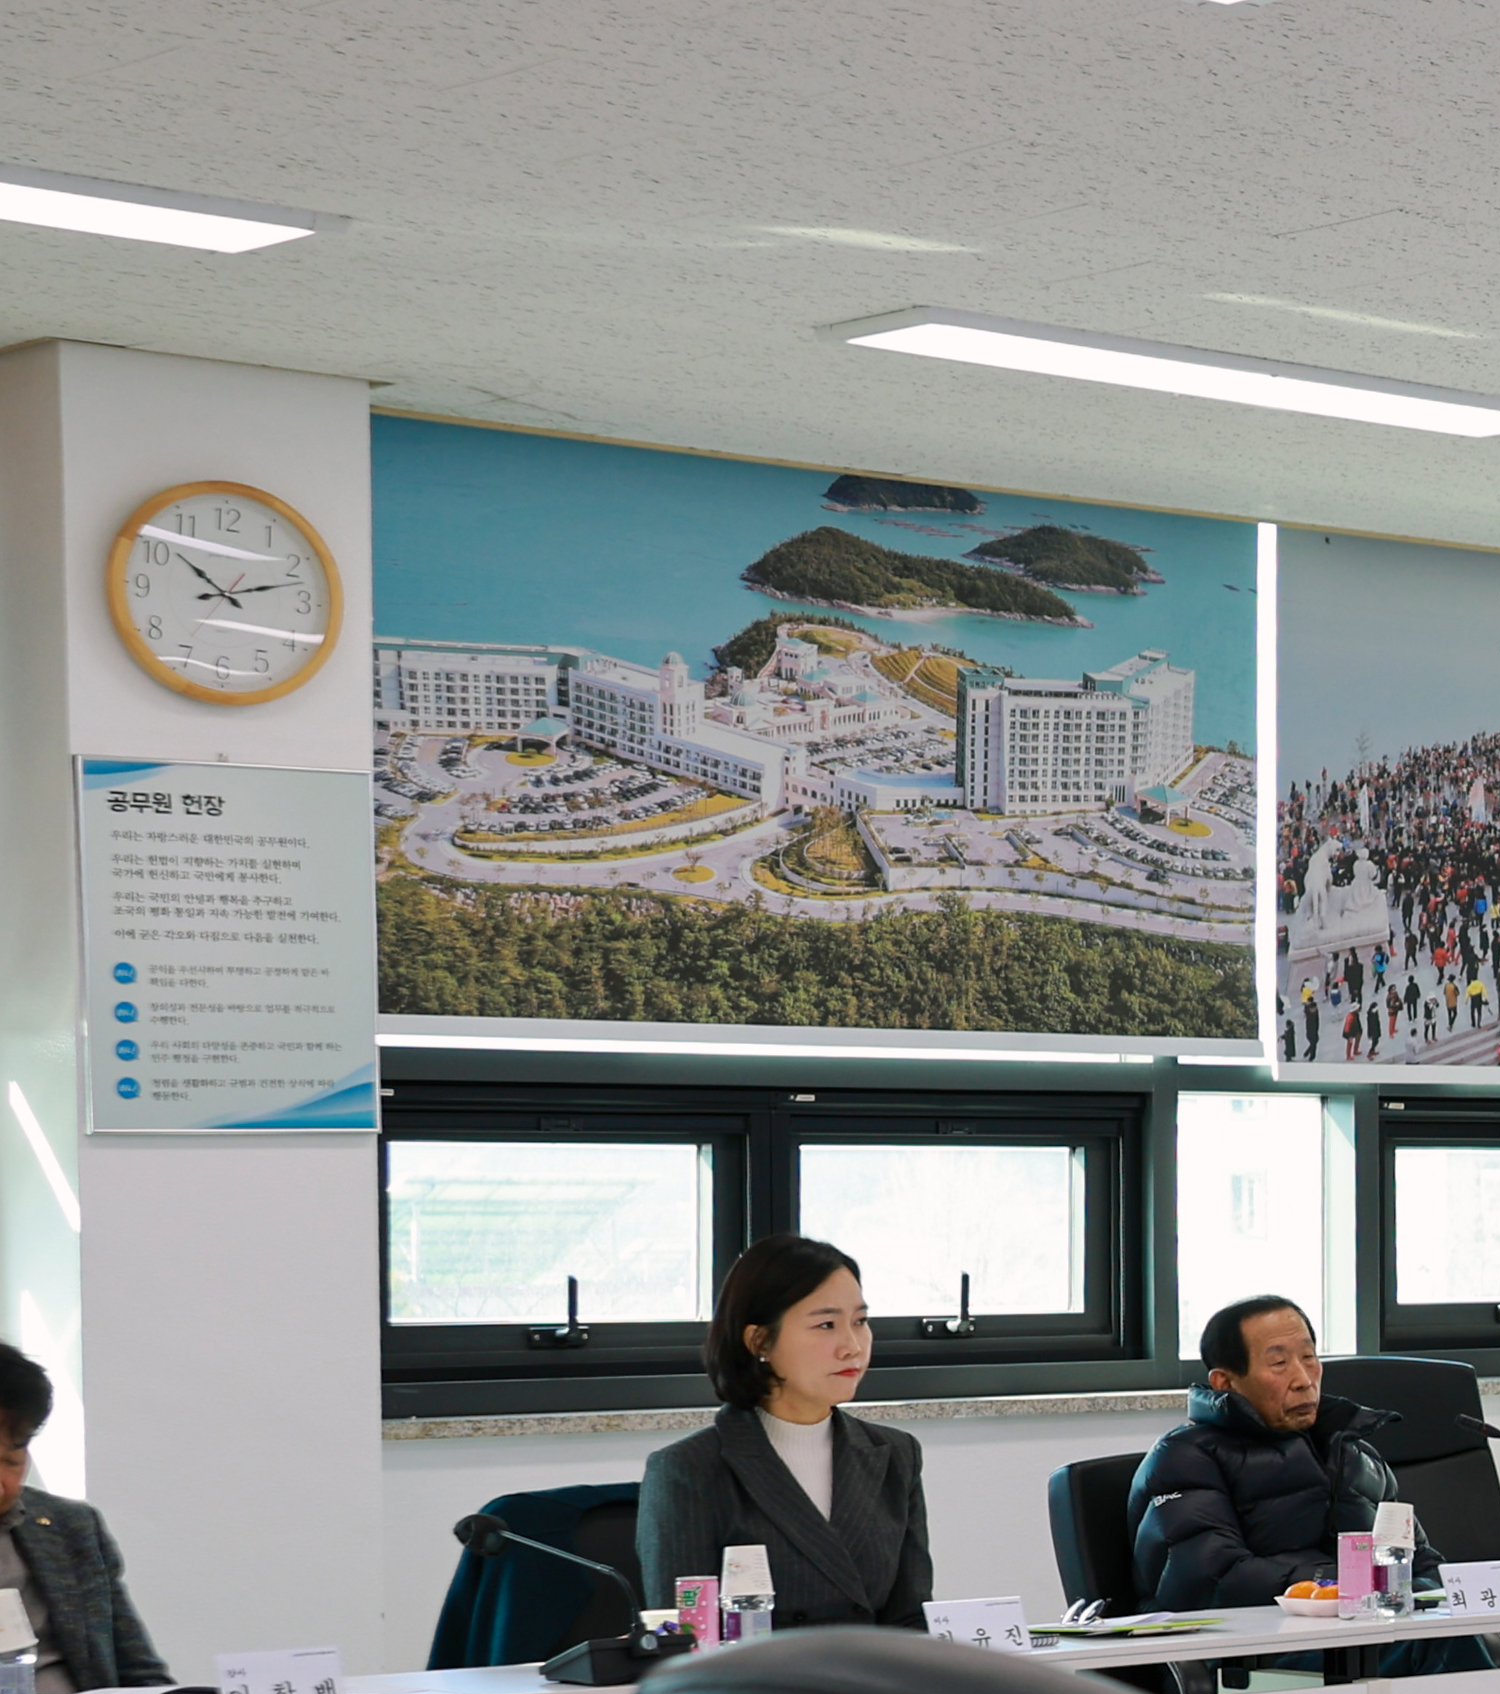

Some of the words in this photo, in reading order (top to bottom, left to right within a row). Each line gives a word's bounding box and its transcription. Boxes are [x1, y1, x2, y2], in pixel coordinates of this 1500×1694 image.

[176, 513, 196, 537] 11
[215, 507, 241, 533] 12
[265, 525, 272, 548] 1
[143, 540, 170, 566] 10
[286, 554, 301, 578] 2
[135, 573, 150, 598] 9
[296, 591, 311, 614] 3
[148, 615, 162, 639] 8
[282, 630, 297, 652] 4
[178, 644, 193, 668] 7
[254, 650, 269, 673] 5
[216, 656, 230, 680] 6
[107, 791, 173, 814] 공무원
[182, 794, 225, 817] 헌장
[111, 830, 142, 842] 우리는
[147, 832, 198, 843] 자랑스러운
[204, 834, 254, 846] 대한민국의
[258, 837, 310, 849] 공무원이다.
[112, 854, 143, 865] 우리는
[112, 869, 144, 880] 국가에
[113, 892, 145, 903] 우리는
[115, 929, 136, 940] 이에
